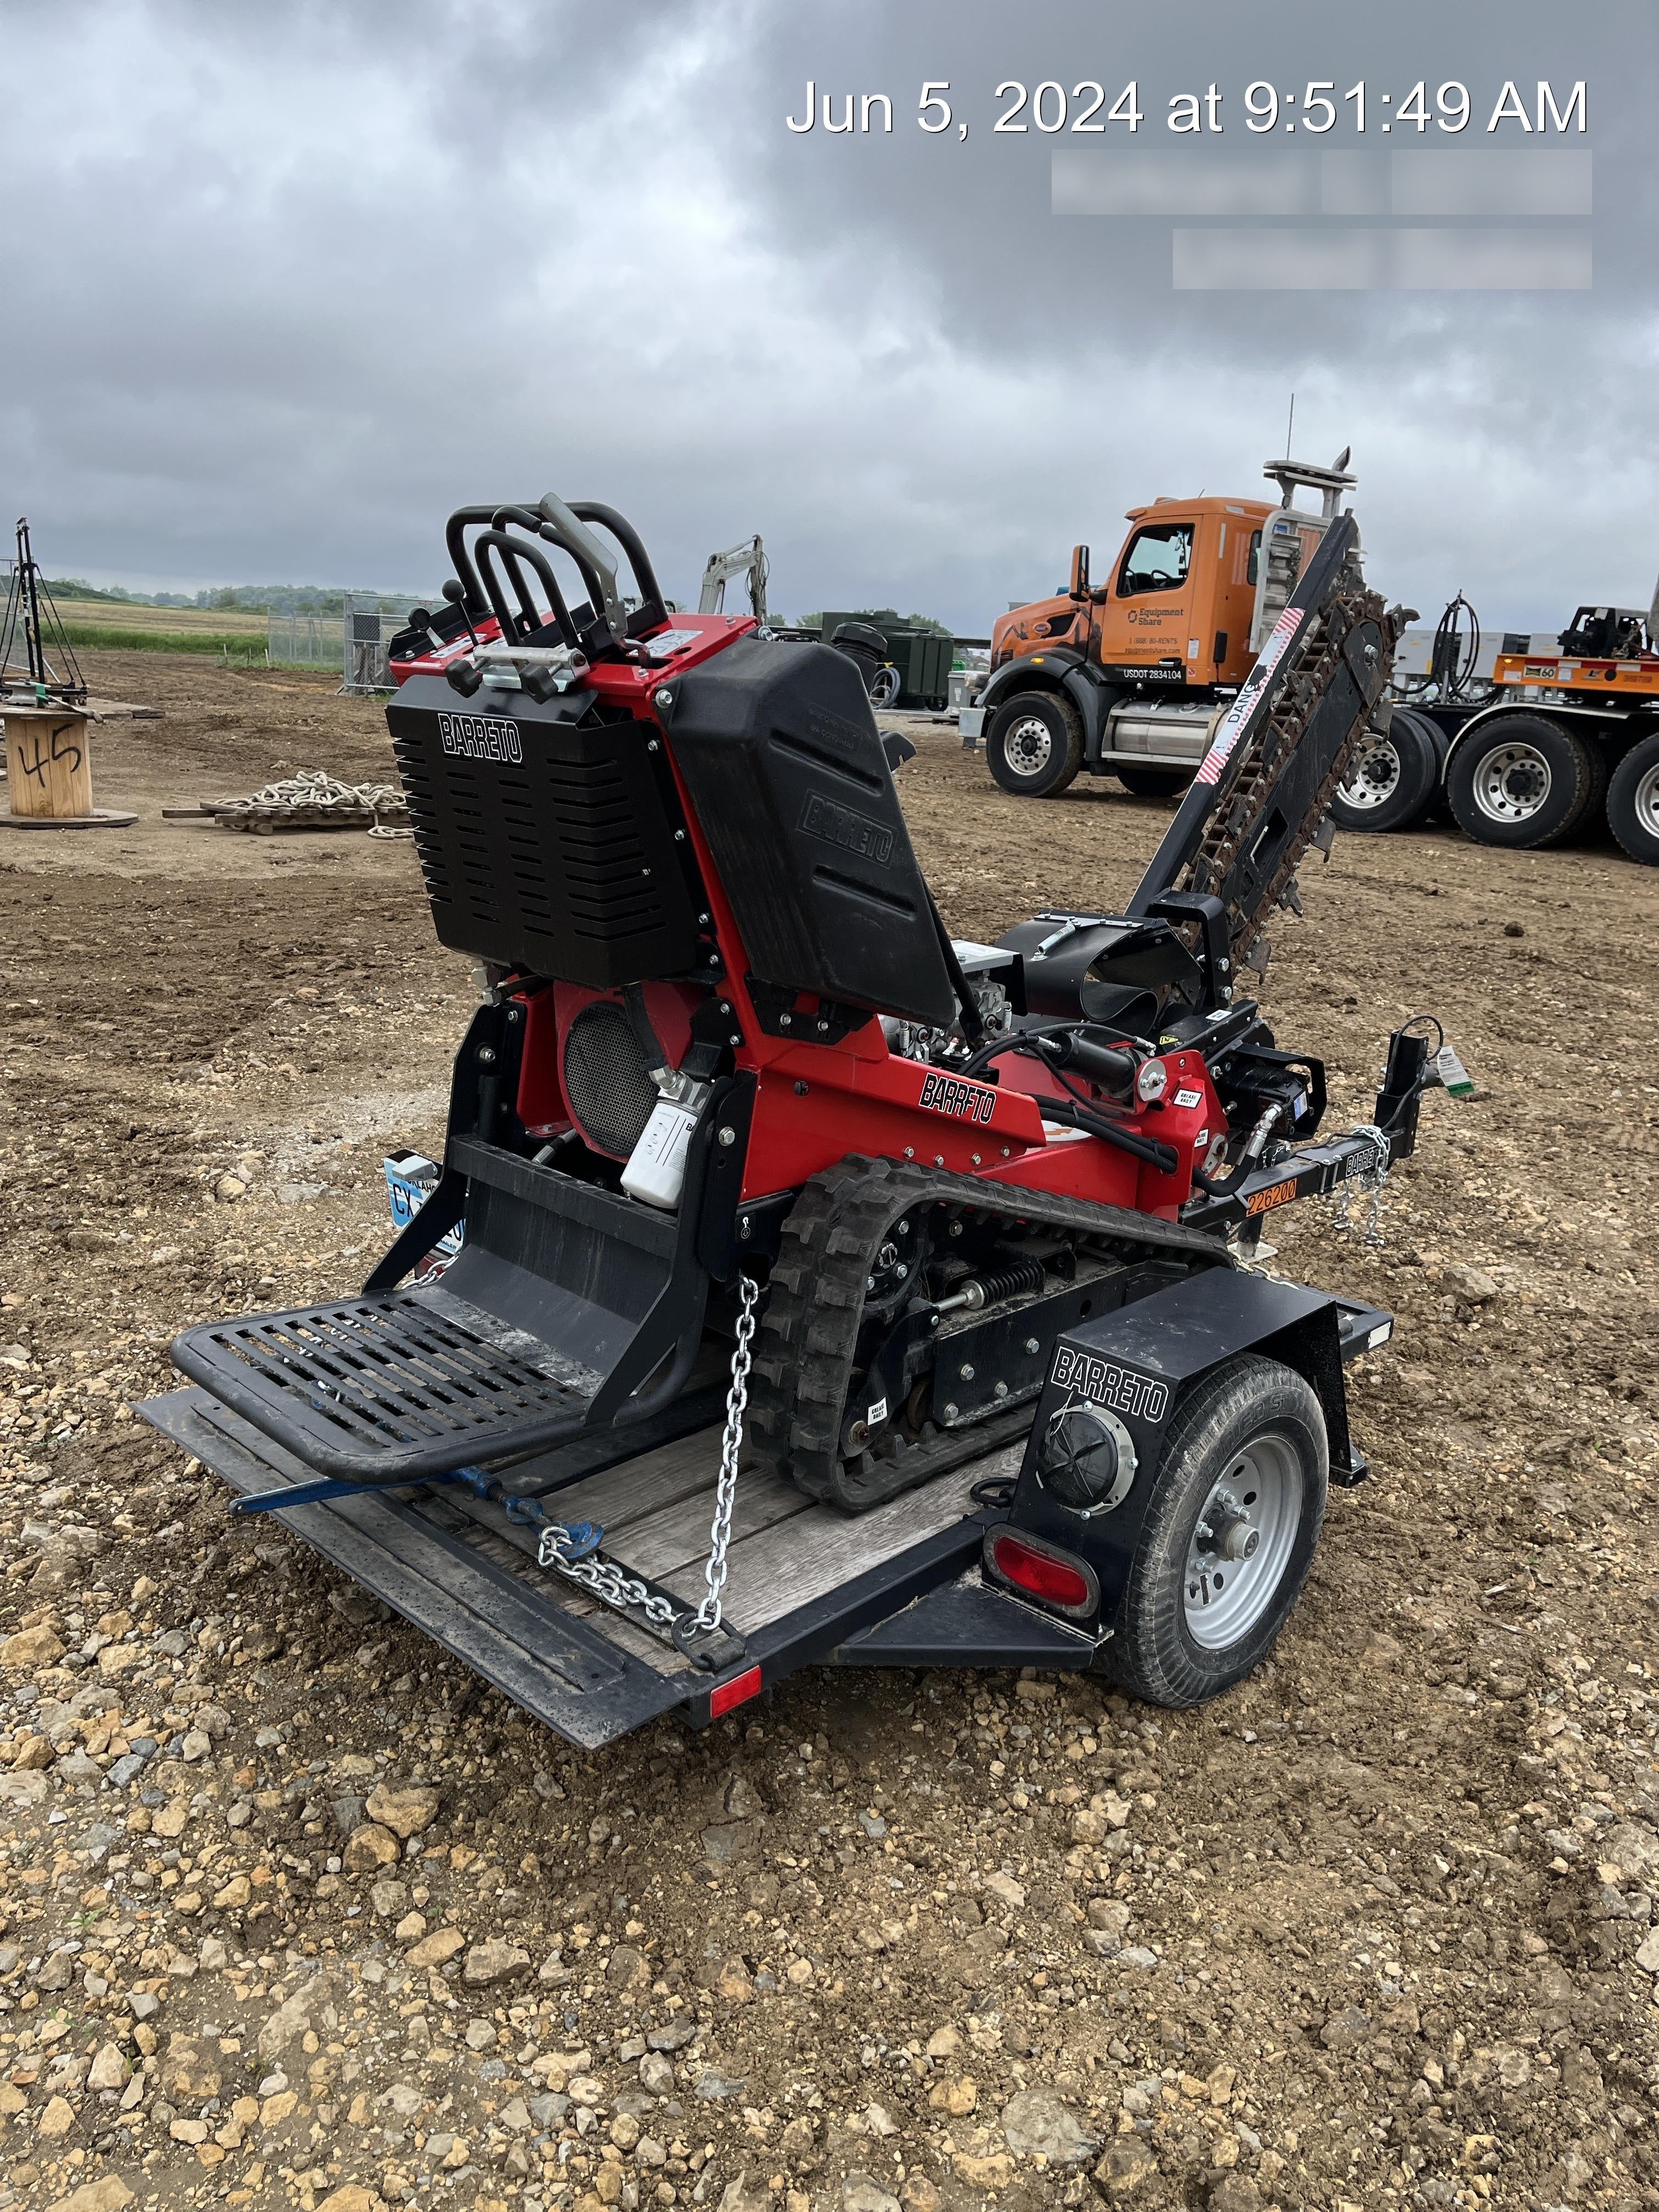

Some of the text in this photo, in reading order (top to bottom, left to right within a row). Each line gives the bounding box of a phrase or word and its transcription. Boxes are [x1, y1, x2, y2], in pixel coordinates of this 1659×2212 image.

[1138, 617, 1161, 625] Share
[1139, 608, 1184, 617] Equipment
[1124, 669, 1182, 680] USDOT 2834104
[1542, 668, 1554, 678] 60
[438, 713, 522, 763] BARRETO
[18, 723, 82, 788] 45
[803, 794, 893, 862] BARRETO
[1346, 1147, 1379, 1178] BARRET
[1248, 1180, 1296, 1215] 226200
[1051, 1346, 1169, 1423] BARRETO
